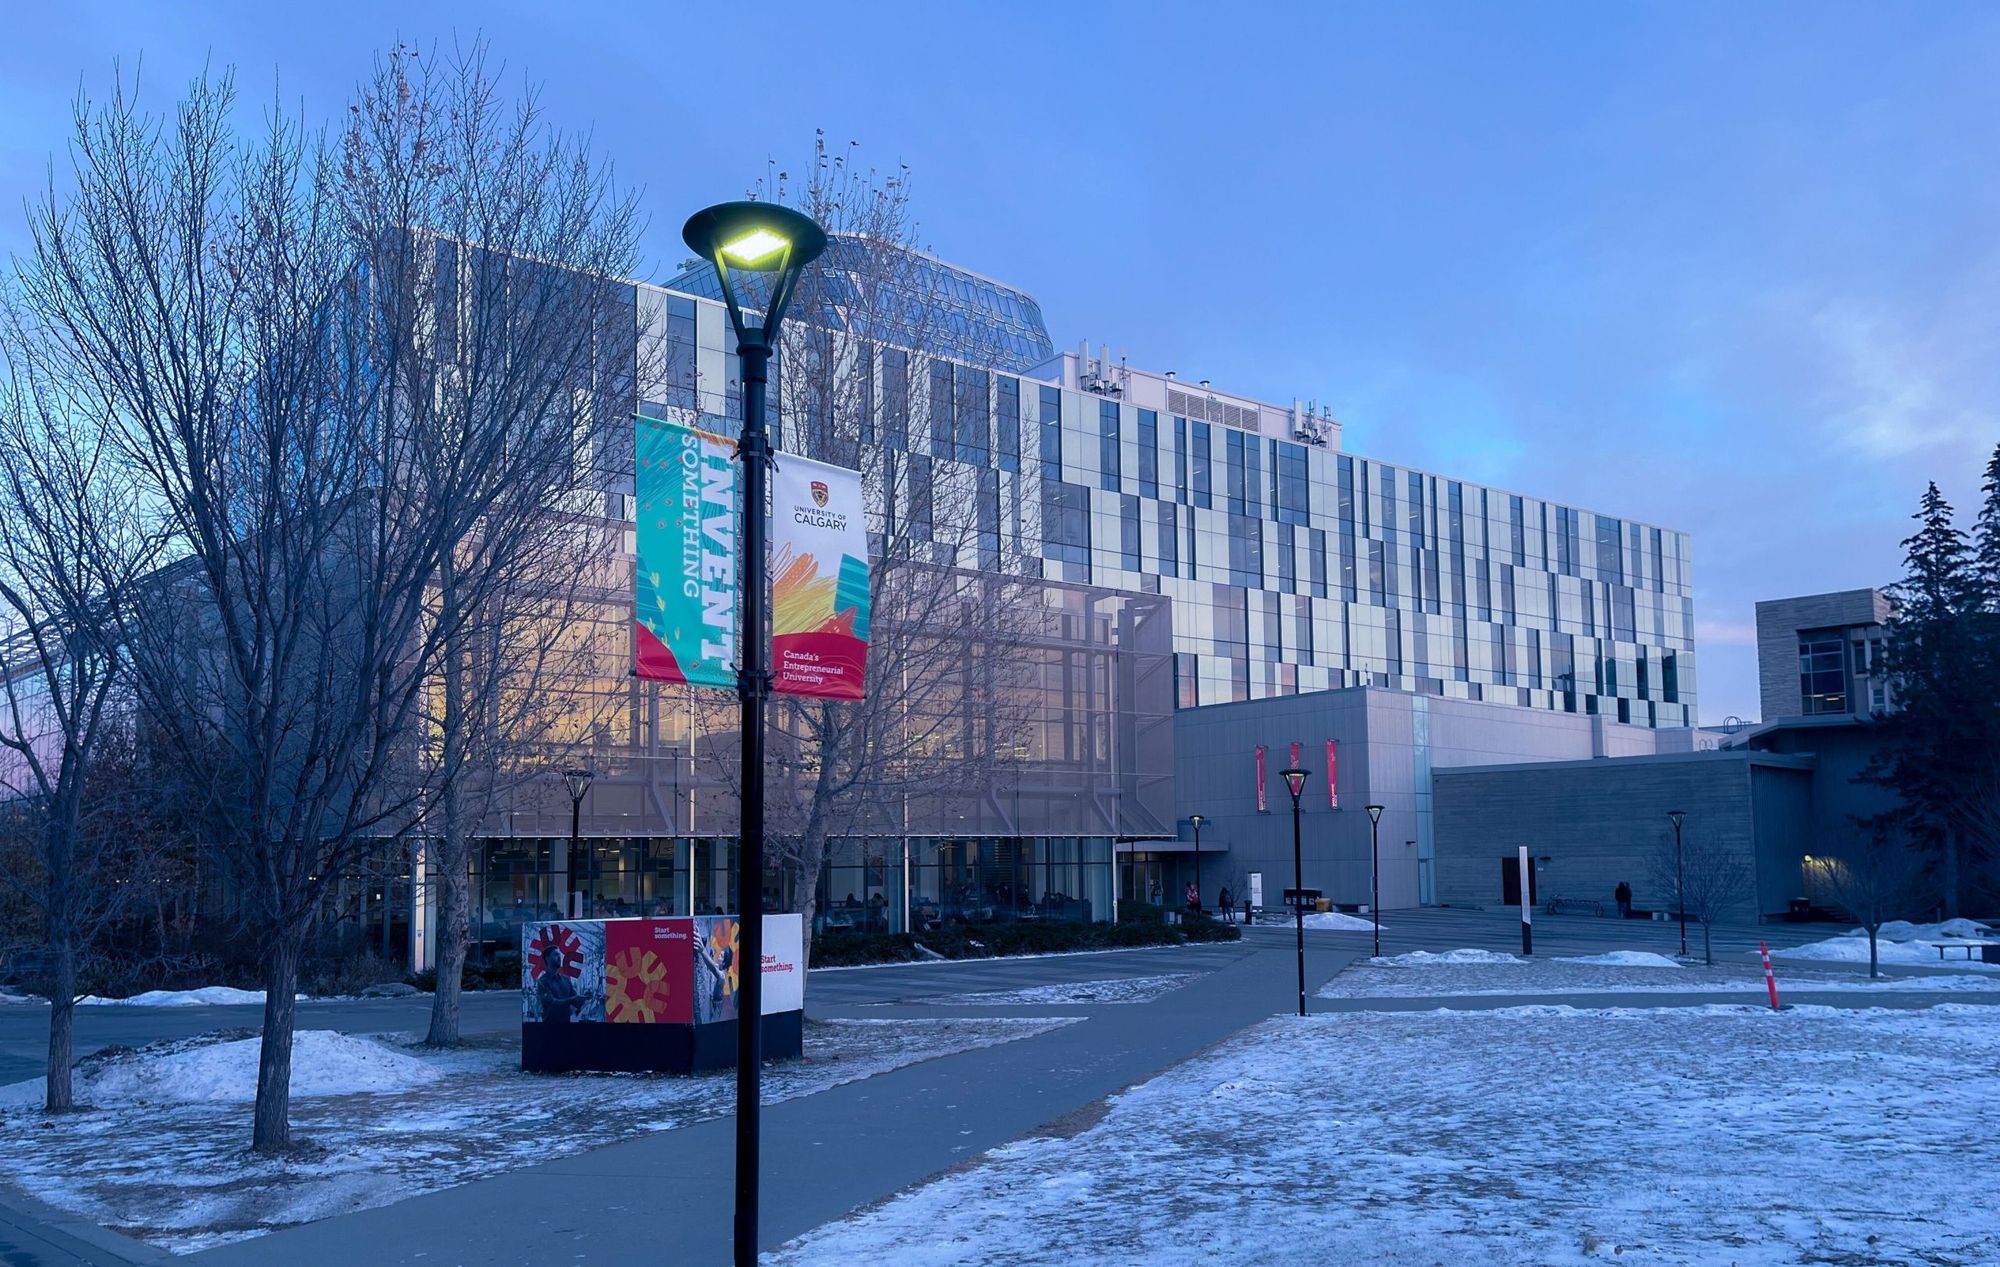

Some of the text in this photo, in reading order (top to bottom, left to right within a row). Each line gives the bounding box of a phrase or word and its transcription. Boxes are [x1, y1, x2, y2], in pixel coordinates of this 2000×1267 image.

[682, 433, 699, 598] SOMETHING
[794, 505, 836, 518] UNIVERSITY
[794, 513, 847, 532] CALGARY
[701, 437, 734, 672] INVENT
[783, 649, 820, 662] Canada's
[783, 660, 844, 675] Entrepreneurial
[782, 672, 824, 685] University
[761, 955, 775, 963] Start
